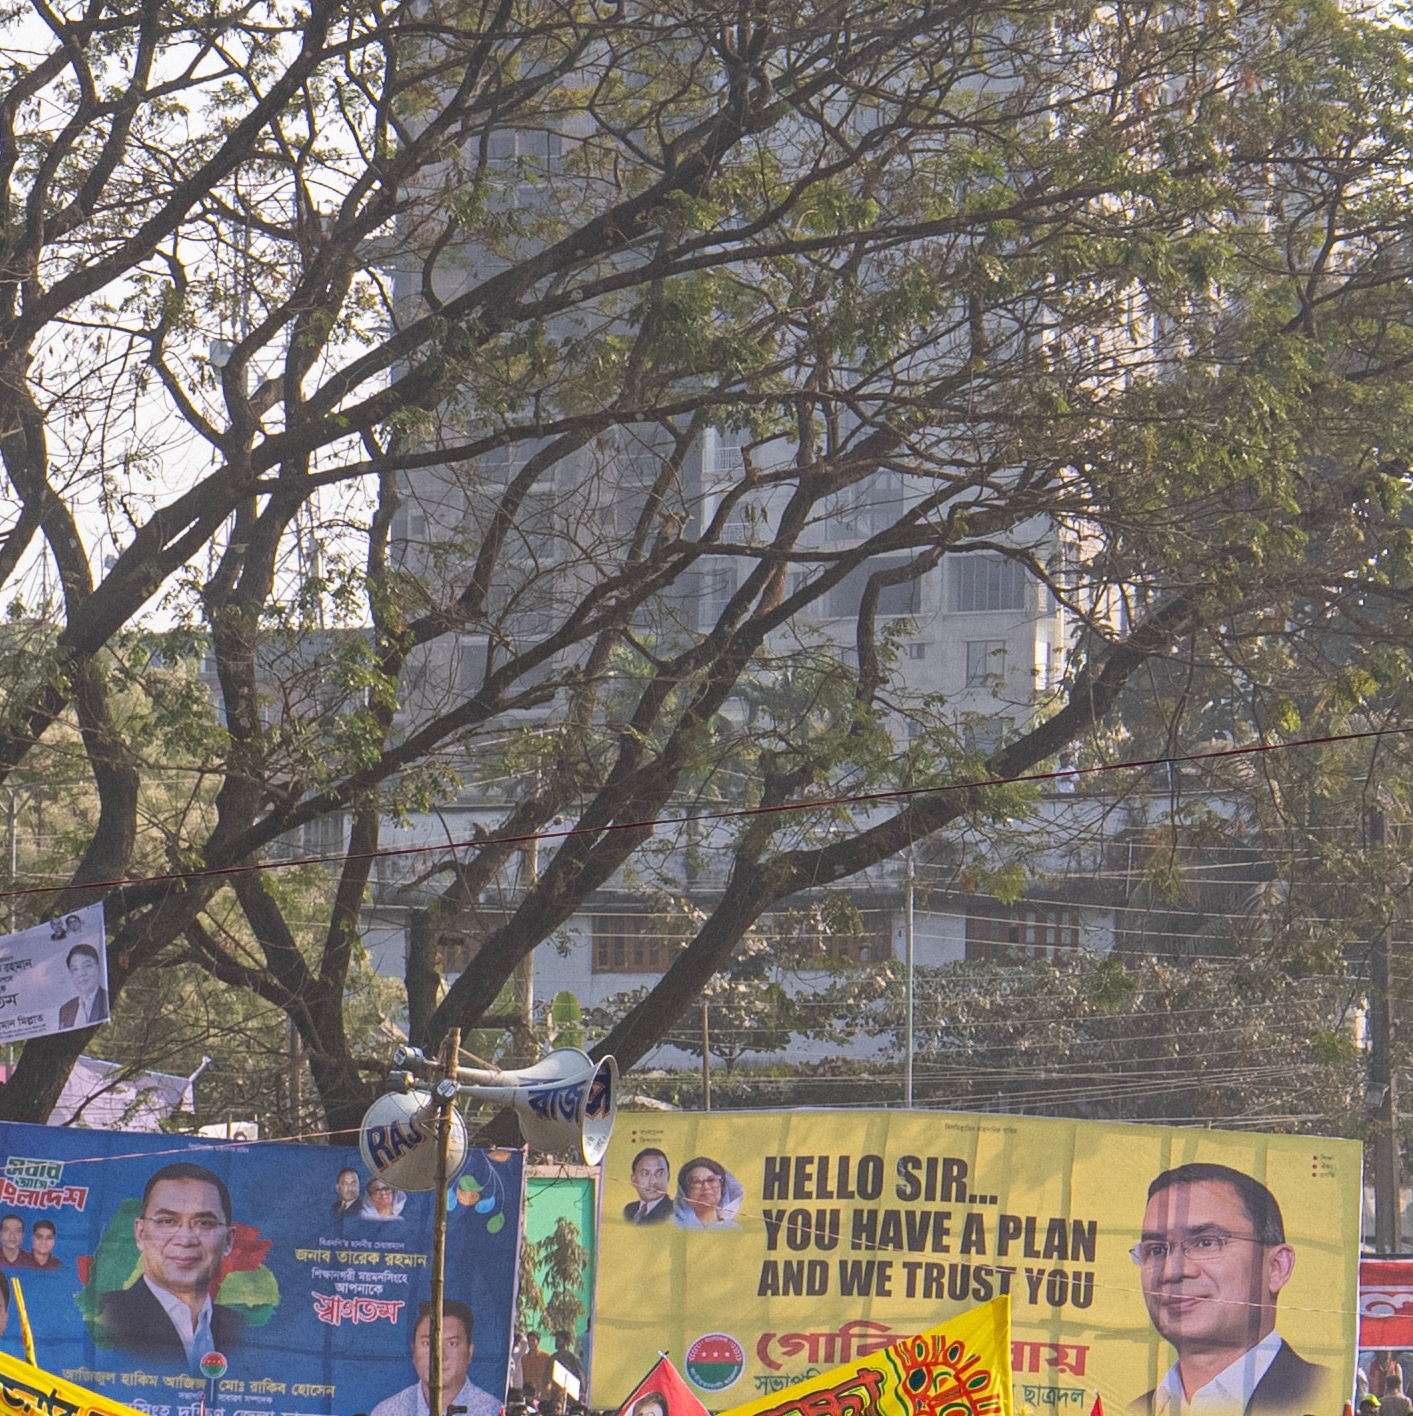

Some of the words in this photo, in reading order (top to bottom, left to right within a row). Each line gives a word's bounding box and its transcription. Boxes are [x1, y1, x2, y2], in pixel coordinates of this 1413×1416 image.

[763, 1154, 884, 1201] HELLO
[896, 1155, 998, 1205] SIR...
[763, 1208, 840, 1251] YOU
[851, 1209, 951, 1253] HAVE
[960, 1213, 986, 1255] A
[997, 1215, 1097, 1262] PLAN
[295, 1248, 330, 1263] জনাব
[336, 1250, 380, 1265] তারেক
[385, 1252, 427, 1267] রহমান
[334, 1281, 384, 1295] আপনাকে
[358, 1269, 409, 1284] ময়মনসিংহে
[757, 1260, 829, 1297] AND
[839, 1260, 893, 1297] WE
[902, 1261, 1017, 1301] TRUST
[1023, 1267, 1095, 1309] YOU
[311, 1291, 405, 1326] স্বাগতম
[120, 1371, 158, 1386] হাকিম
[162, 1372, 207, 1389] আজিজ
[250, 1378, 286, 1394] রাকিব
[291, 1382, 336, 1398] হোসেন
[1022, 1381, 1085, 1409] ছাত্রদল
